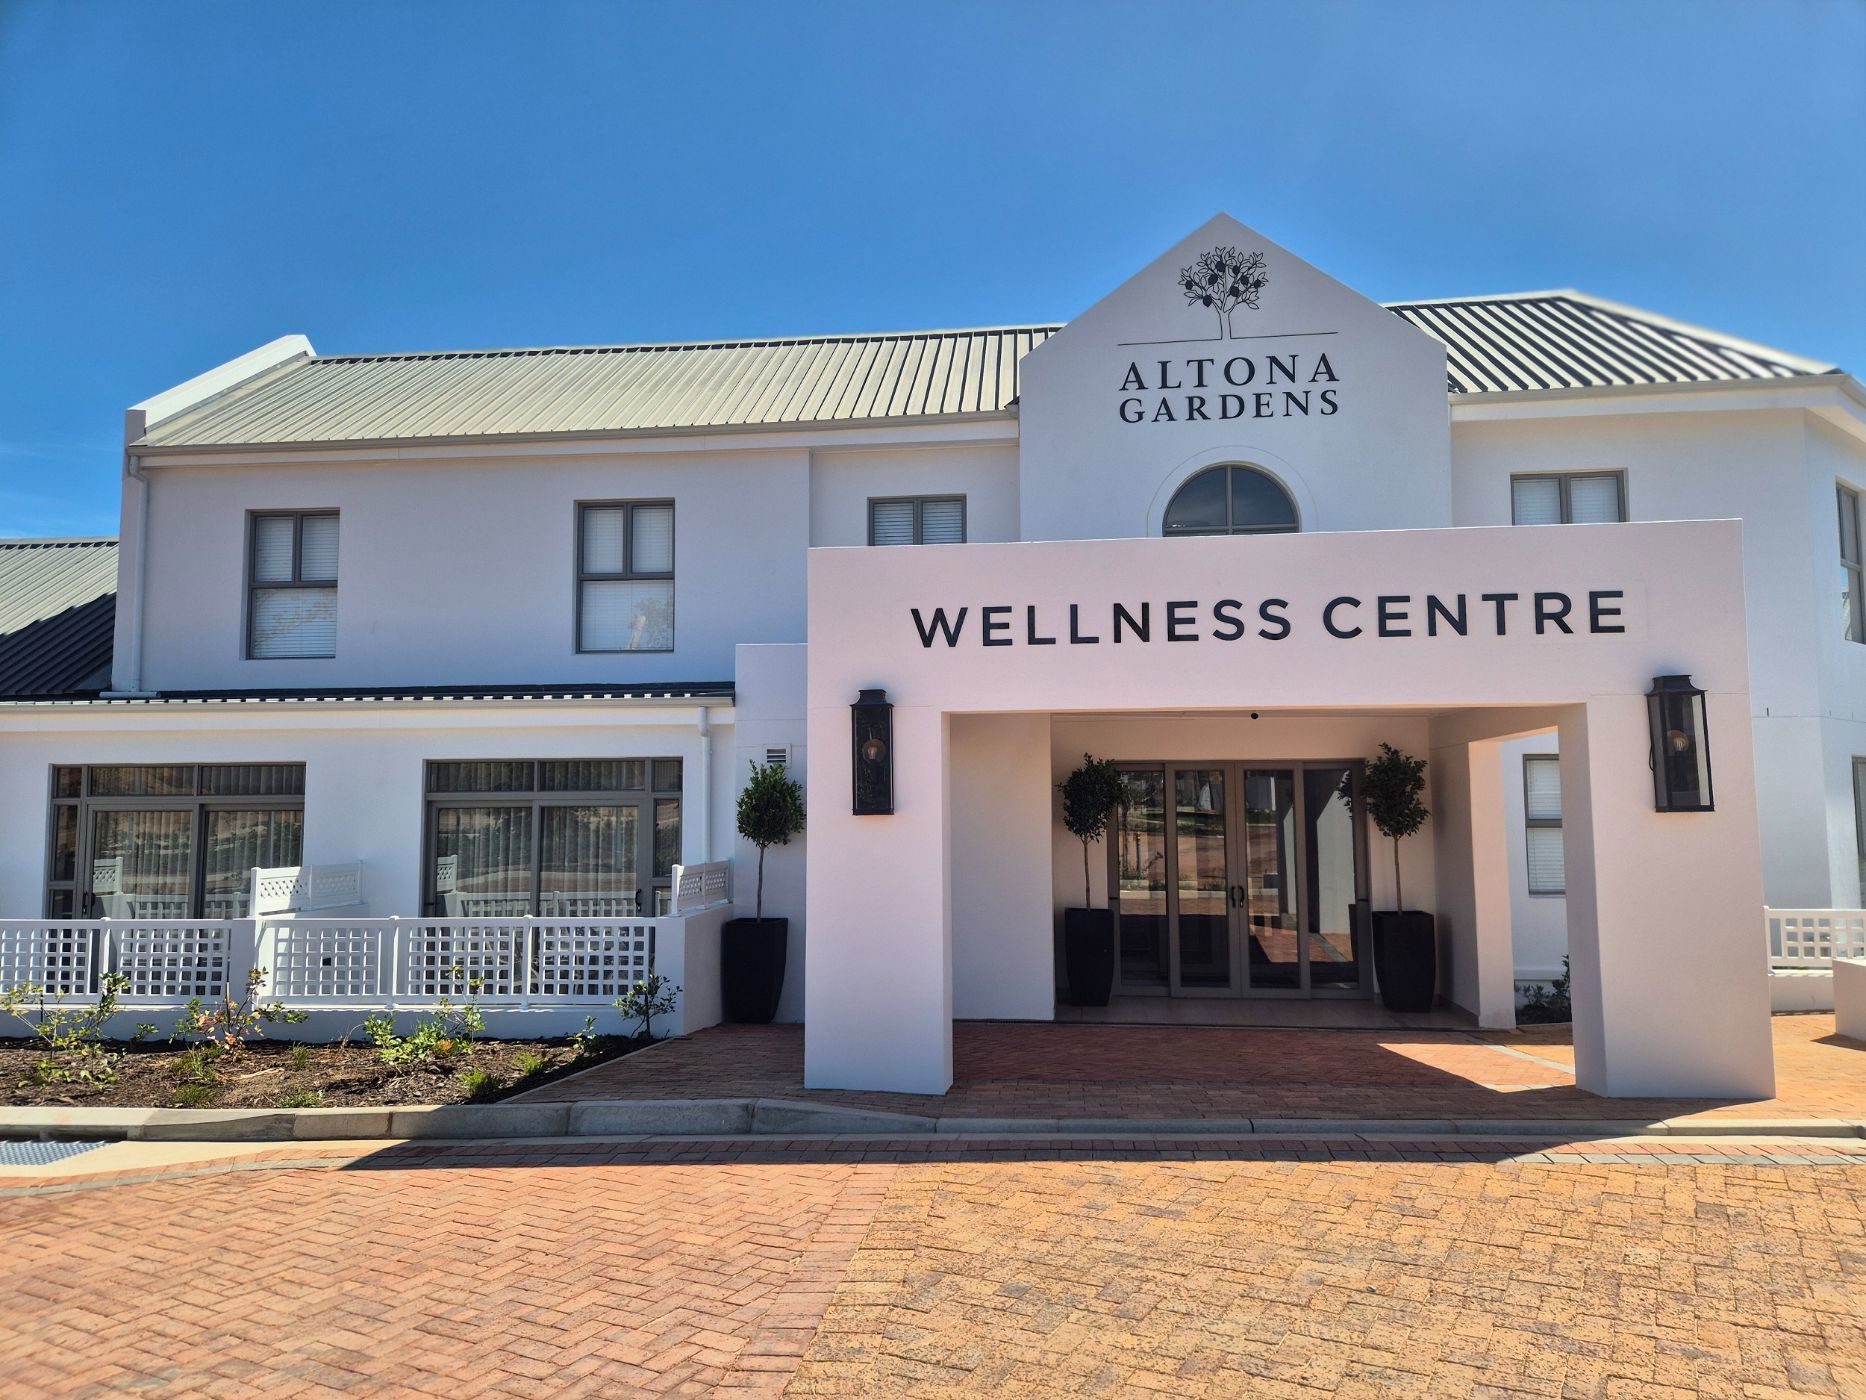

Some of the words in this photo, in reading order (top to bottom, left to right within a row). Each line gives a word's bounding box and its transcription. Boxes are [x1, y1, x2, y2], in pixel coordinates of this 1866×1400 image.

[1118, 352, 1340, 391] ALTONA
[1119, 389, 1339, 424] GARDENS
[911, 599, 1291, 648] WELLNESS
[1323, 591, 1625, 639] CENTRE
